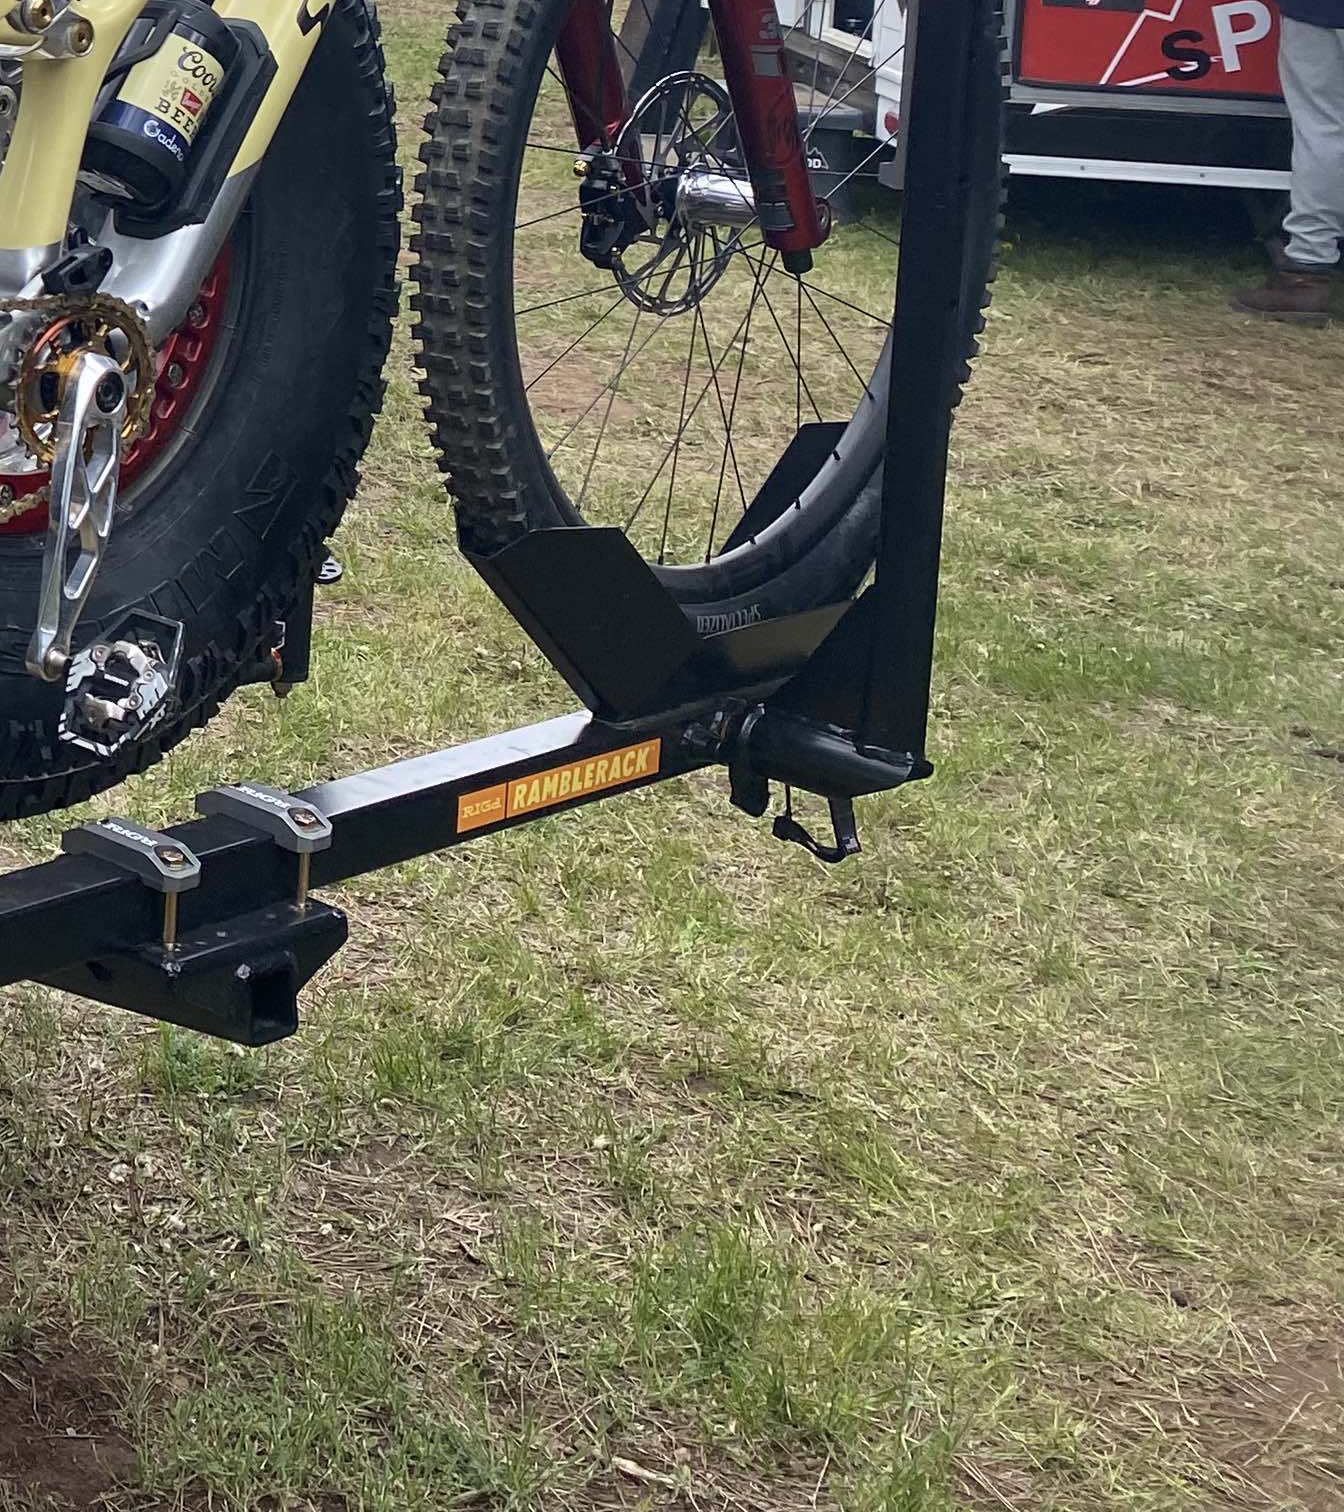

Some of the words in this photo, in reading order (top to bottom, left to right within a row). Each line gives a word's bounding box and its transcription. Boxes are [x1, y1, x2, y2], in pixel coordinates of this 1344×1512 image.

[178, 47, 217, 92] Coor
[1161, 0, 1272, 82] sP
[513, 747, 650, 810] RAMBLERACK
